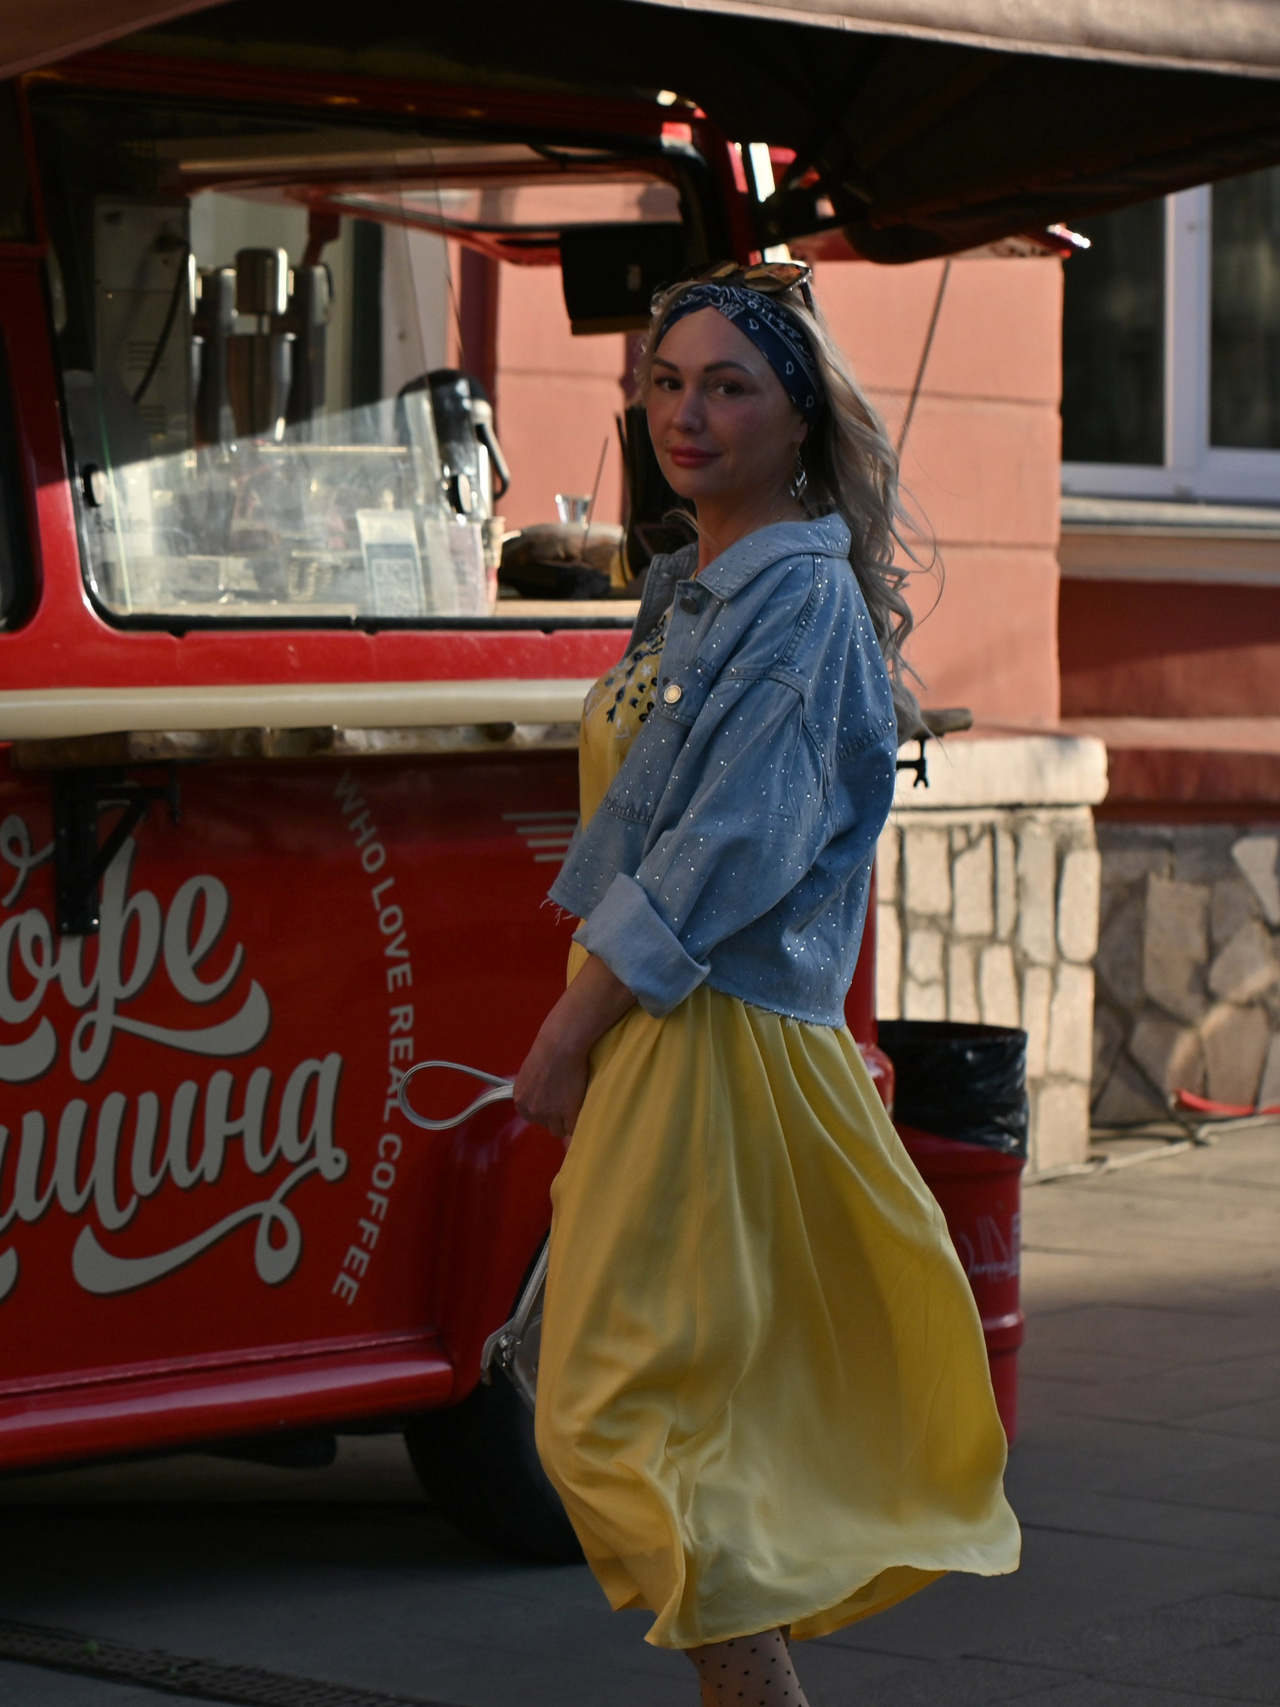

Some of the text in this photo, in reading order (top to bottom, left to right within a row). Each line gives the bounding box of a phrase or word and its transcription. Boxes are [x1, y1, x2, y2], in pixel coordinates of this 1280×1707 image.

[332, 767, 415, 1306] WHO LOVE REAL COFFEE
